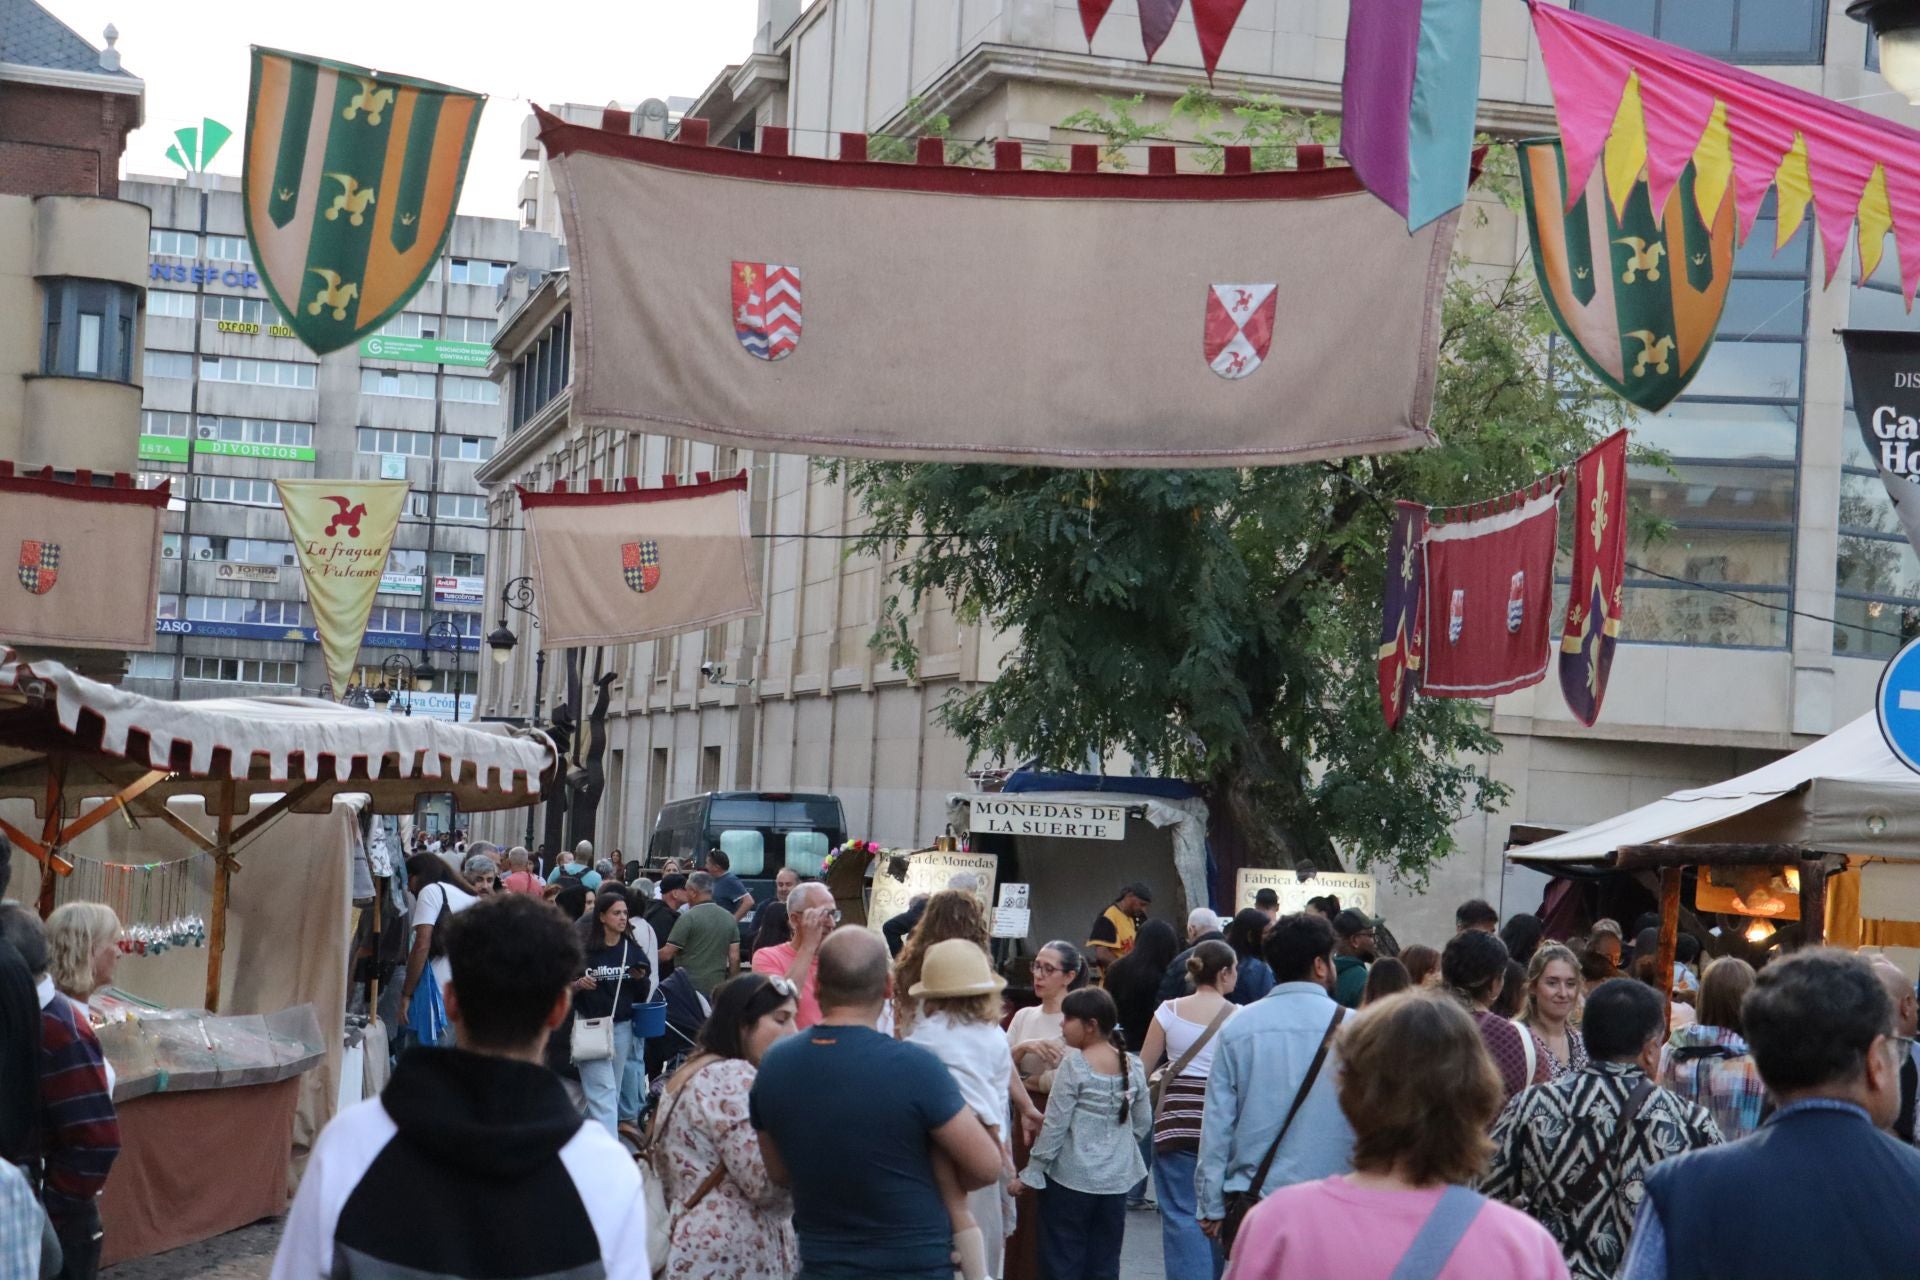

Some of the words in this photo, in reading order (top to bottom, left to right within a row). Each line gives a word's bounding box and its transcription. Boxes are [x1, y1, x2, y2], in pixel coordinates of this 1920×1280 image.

[218, 321, 259, 334] OXFORD
[440, 353, 464, 361] CONTRA
[1872, 406, 1920, 440] Ga
[212, 442, 298, 458] DIVORCIOS
[306, 541, 326, 556] La
[326, 542, 382, 562] fragua
[321, 563, 379, 577] Vulcano
[197, 626, 238, 636] SEGUROS
[368, 637, 407, 646] SEGUROS
[429, 696, 471, 709] Crónca
[976, 802, 1083, 819] MONEDAS
[1092, 808, 1120, 822] DE
[988, 819, 1014, 832] LA
[1023, 821, 1107, 838] SUERTE
[924, 855, 938, 865] de
[942, 856, 994, 869] Monedas
[1244, 873, 1291, 885] Fábrica
[1314, 876, 1371, 889] Monedas
